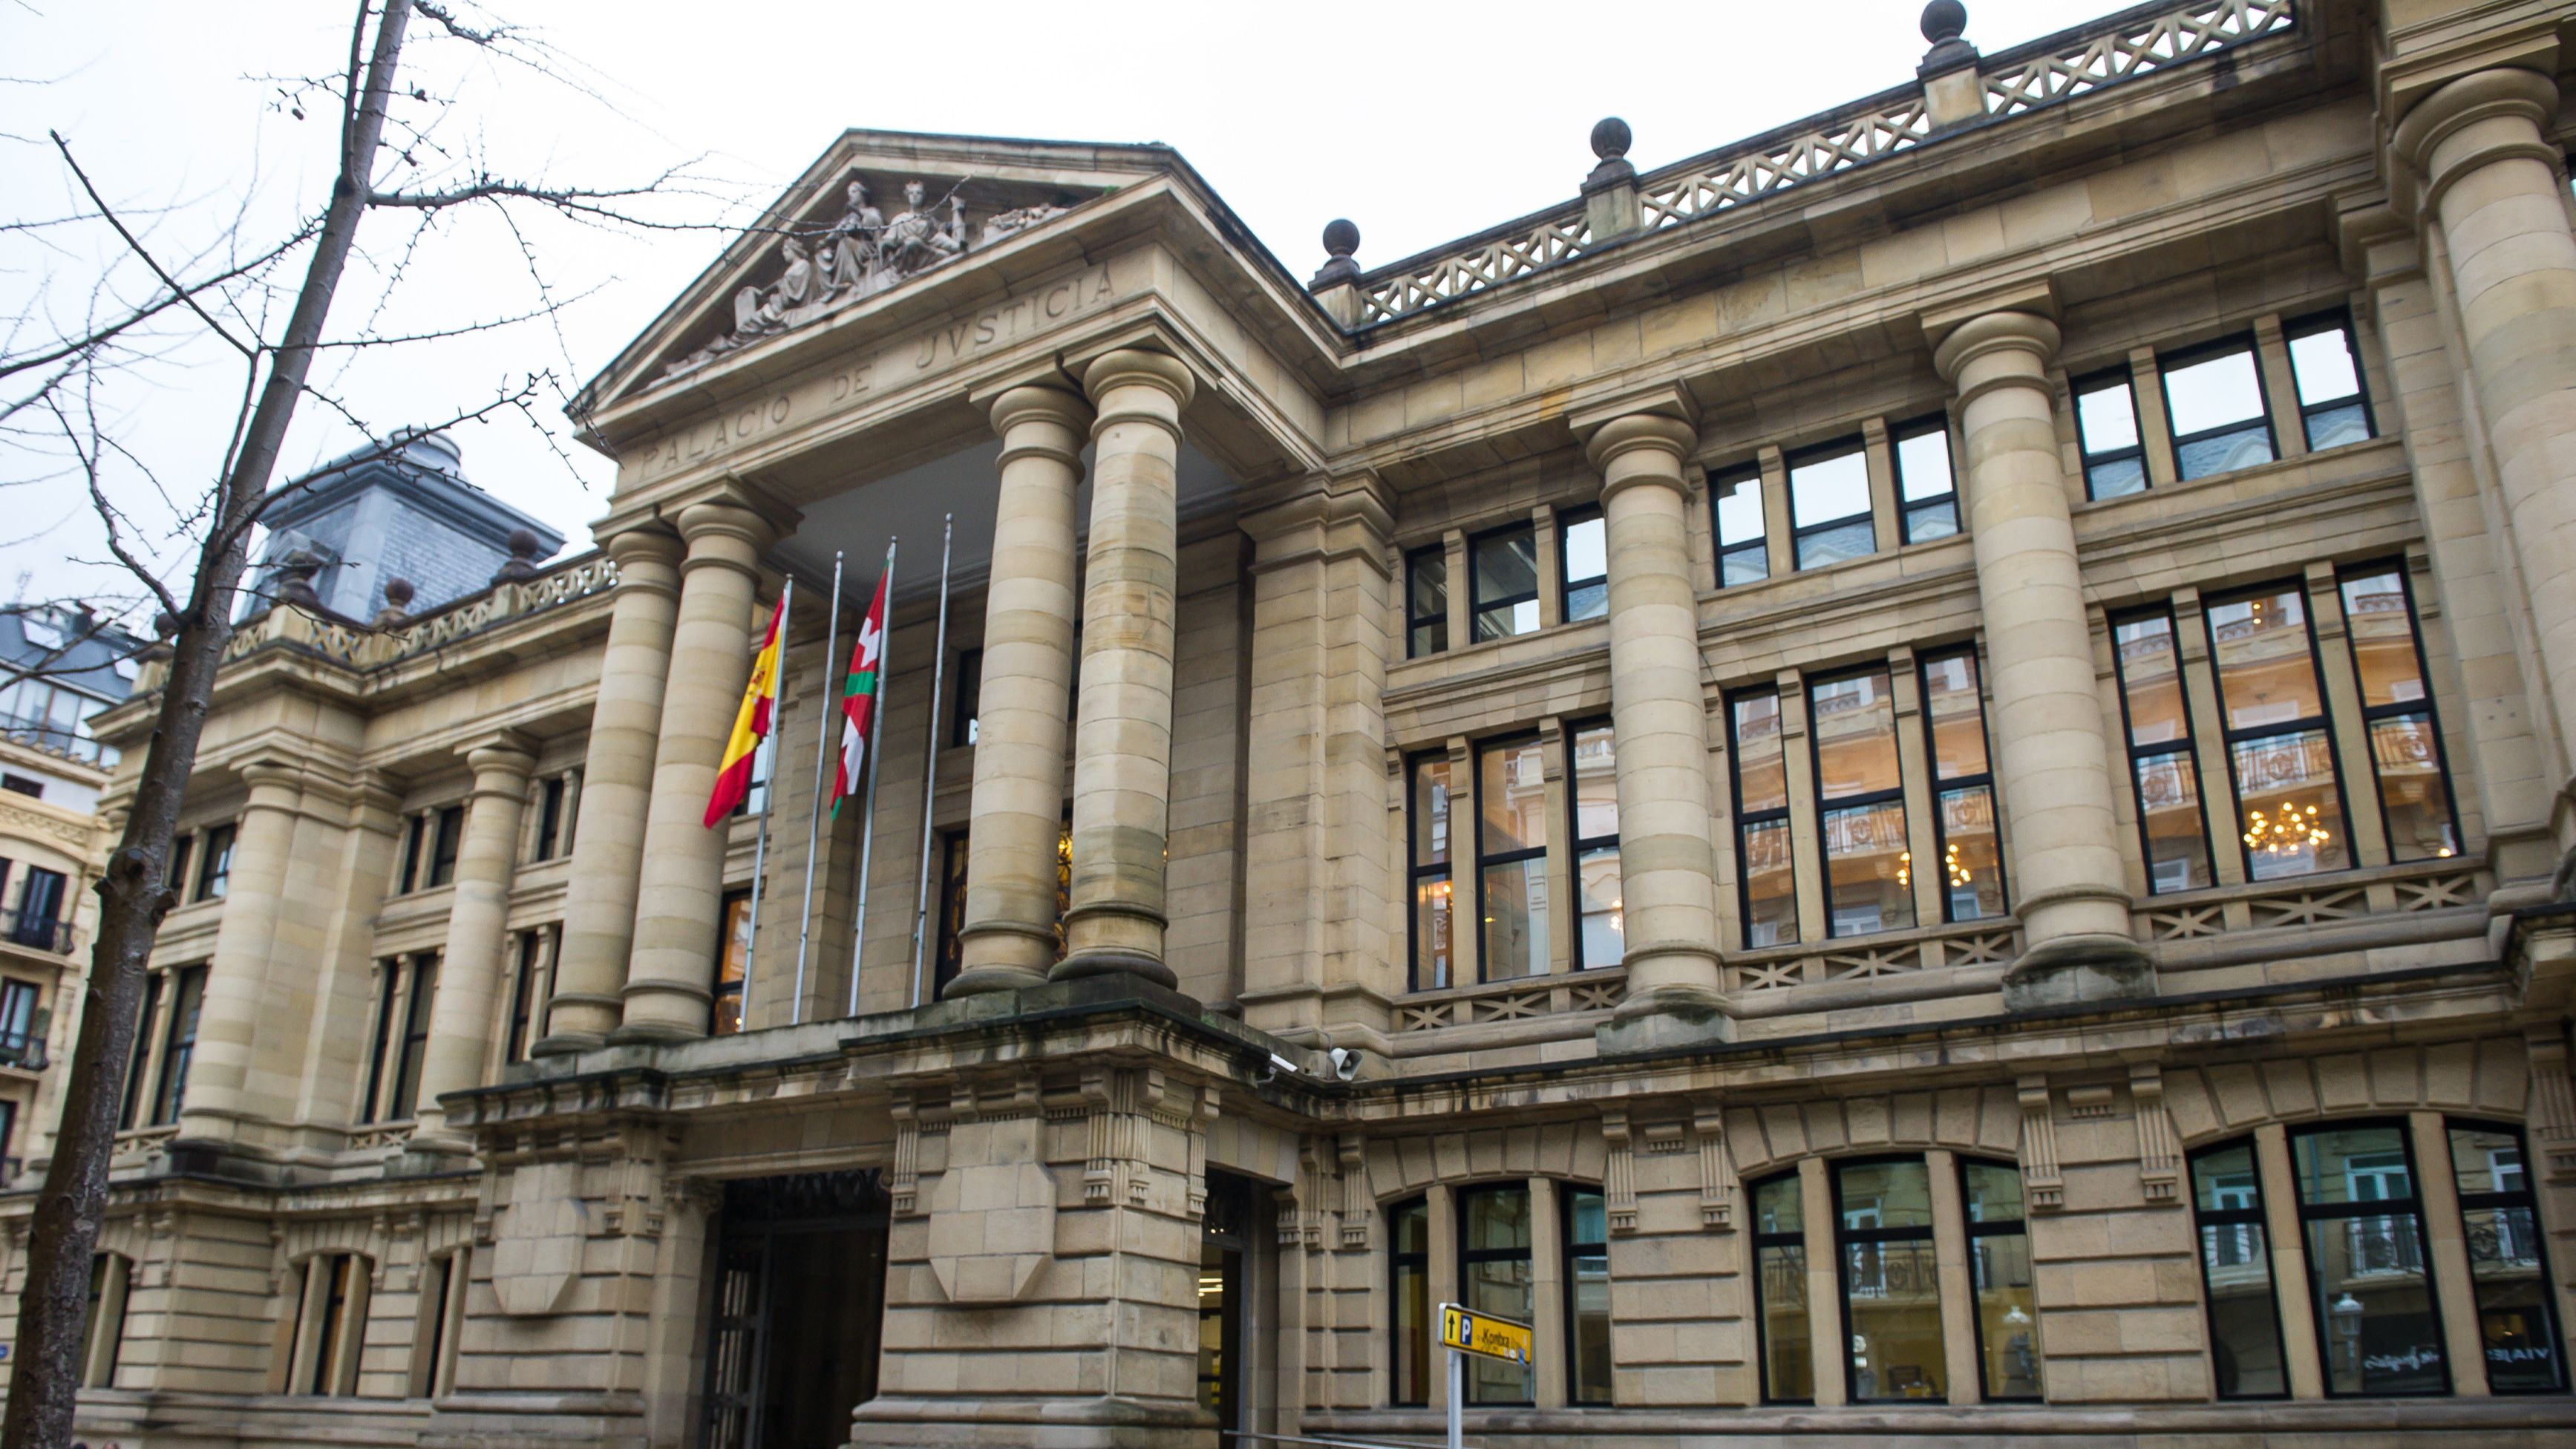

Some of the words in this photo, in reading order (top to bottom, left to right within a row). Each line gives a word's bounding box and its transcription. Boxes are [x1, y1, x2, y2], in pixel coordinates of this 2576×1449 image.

[640, 396, 791, 479] PALACIO
[831, 364, 874, 403] DE
[915, 261, 1114, 369] JVSTICIA
[1462, 1318, 1471, 1342] P
